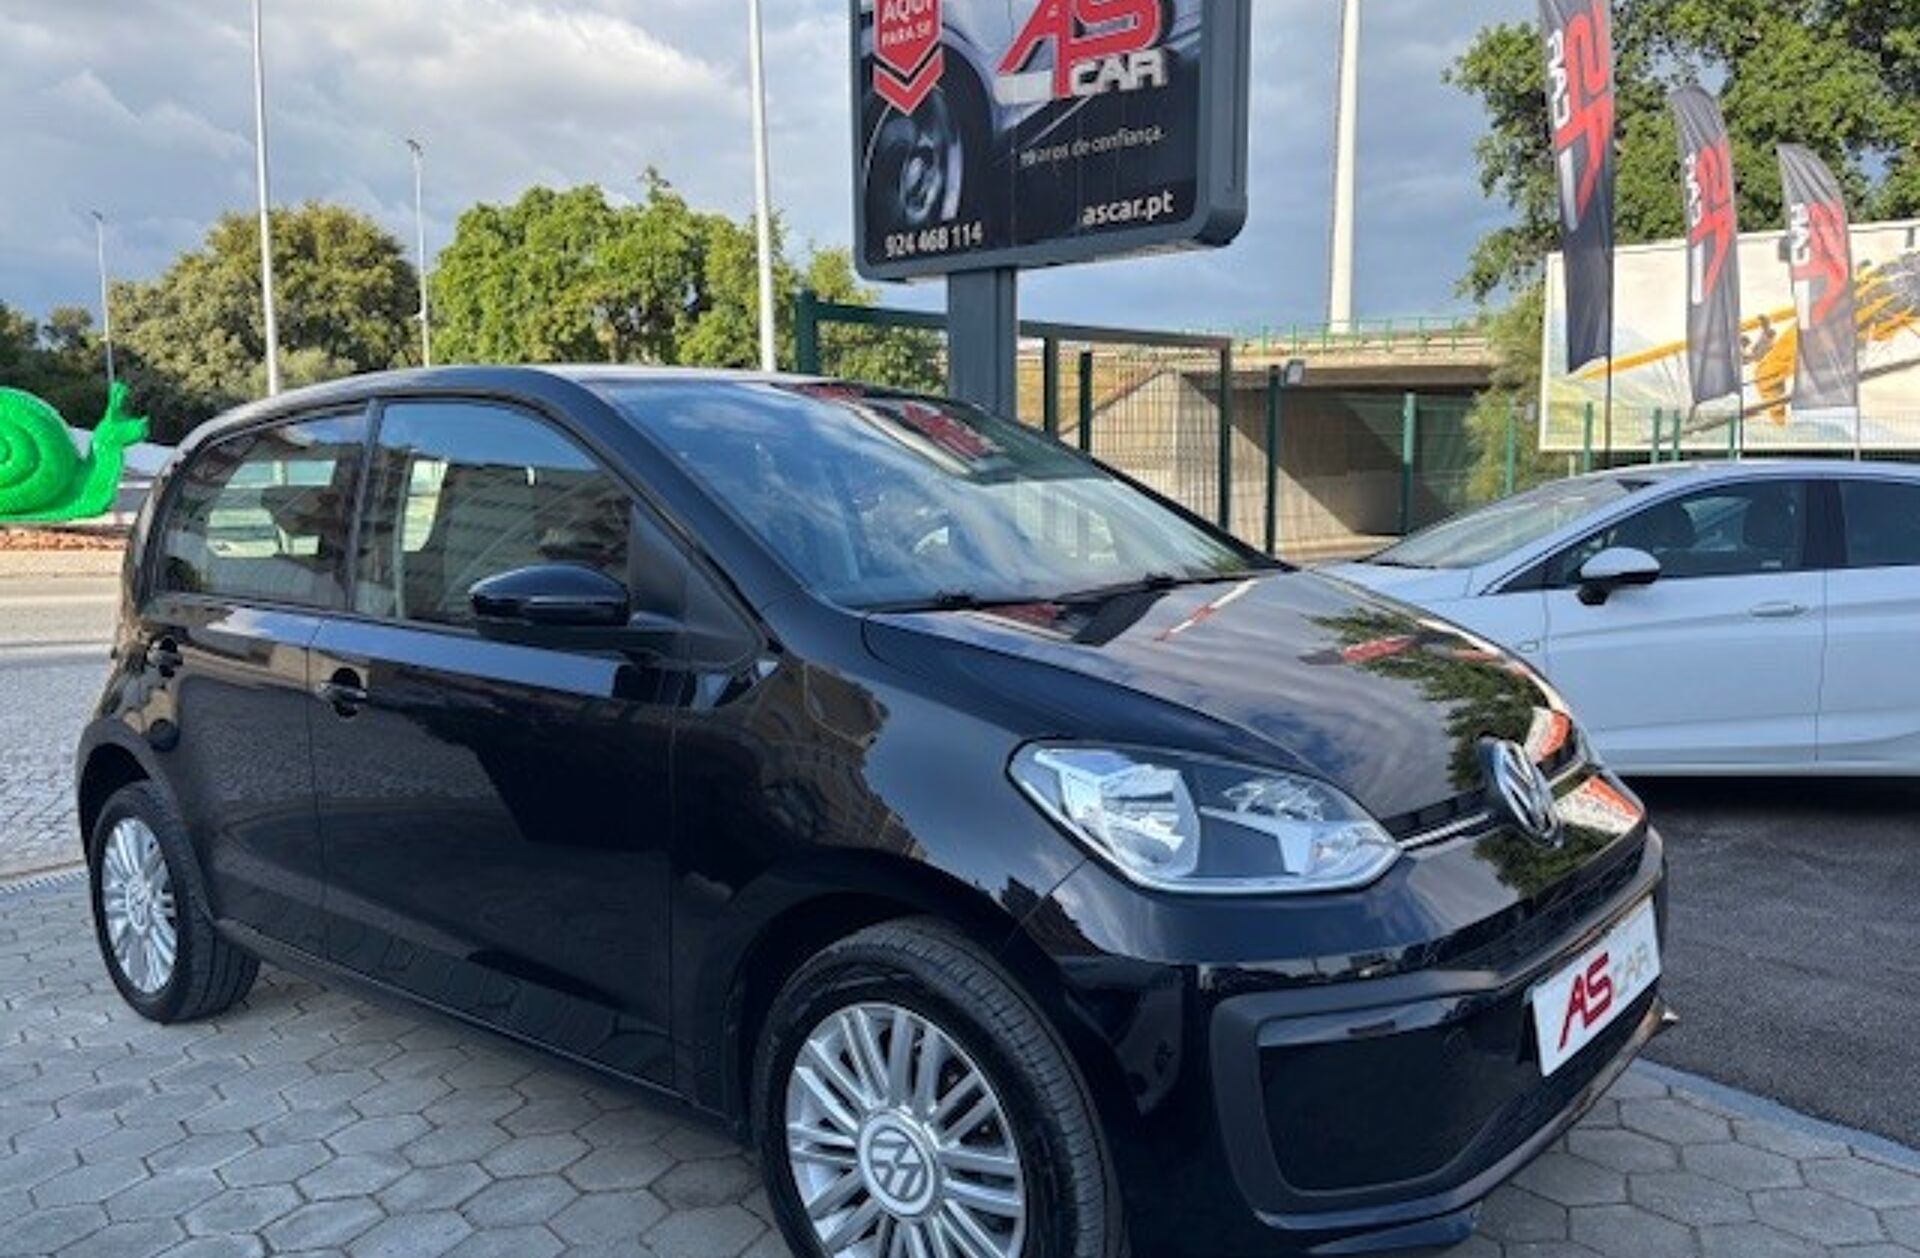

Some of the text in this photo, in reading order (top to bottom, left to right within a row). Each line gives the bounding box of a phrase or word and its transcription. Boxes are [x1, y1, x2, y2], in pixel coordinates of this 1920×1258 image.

[996, 0, 1162, 99] AS
[1070, 49, 1167, 96] CAR
[1071, 139, 1090, 157] de
[1082, 189, 1174, 225] ascar.pt
[885, 232, 915, 257] 924
[951, 220, 983, 249] 114
[1558, 951, 1612, 1052] AS
